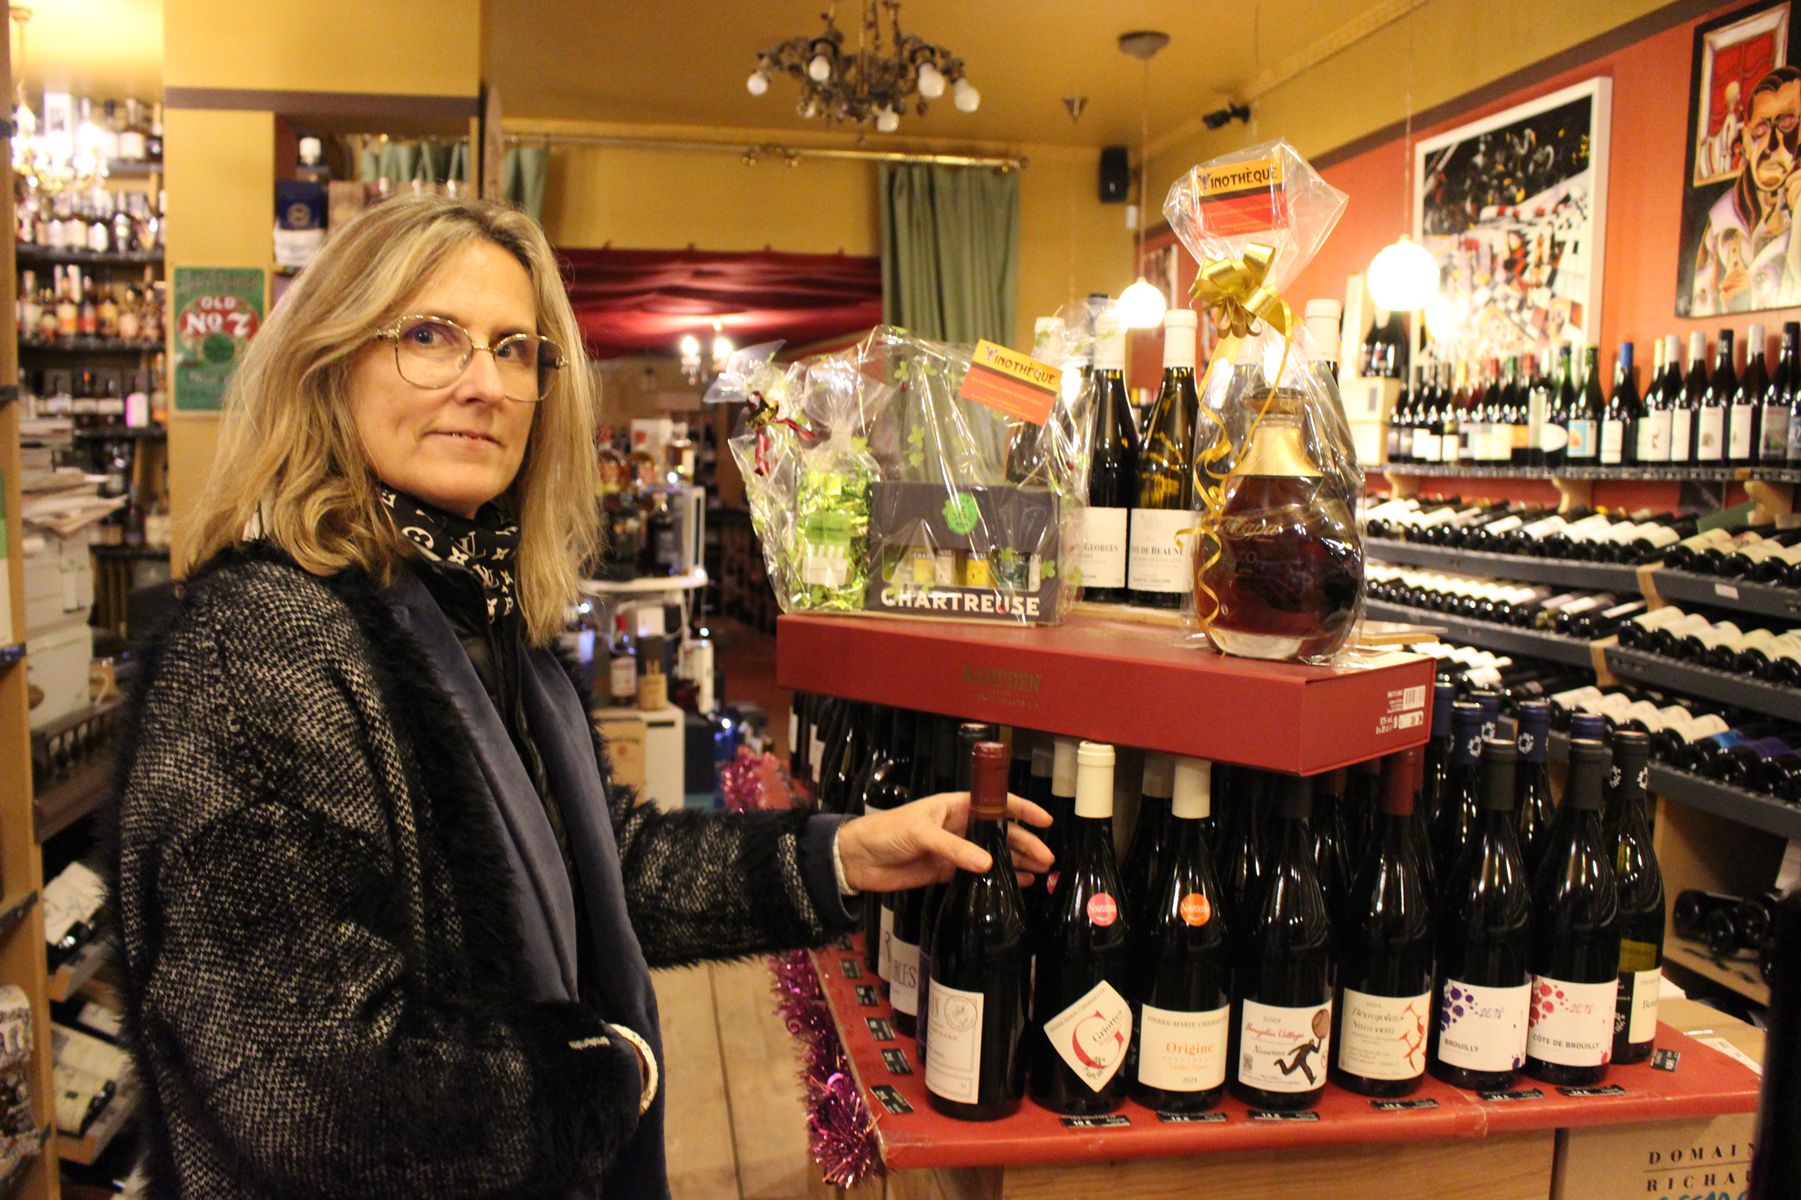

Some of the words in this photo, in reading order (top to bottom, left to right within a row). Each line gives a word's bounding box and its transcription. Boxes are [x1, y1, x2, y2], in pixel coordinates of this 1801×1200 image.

[201, 295, 236, 310] OLD
[880, 587, 1040, 616] CHARTREUSE
[1166, 1040, 1214, 1057] Origine
[1444, 1038, 1479, 1053] BROUILLY
[1552, 1039, 1563, 1047] DE
[1565, 1041, 1600, 1050] BROUILLY
